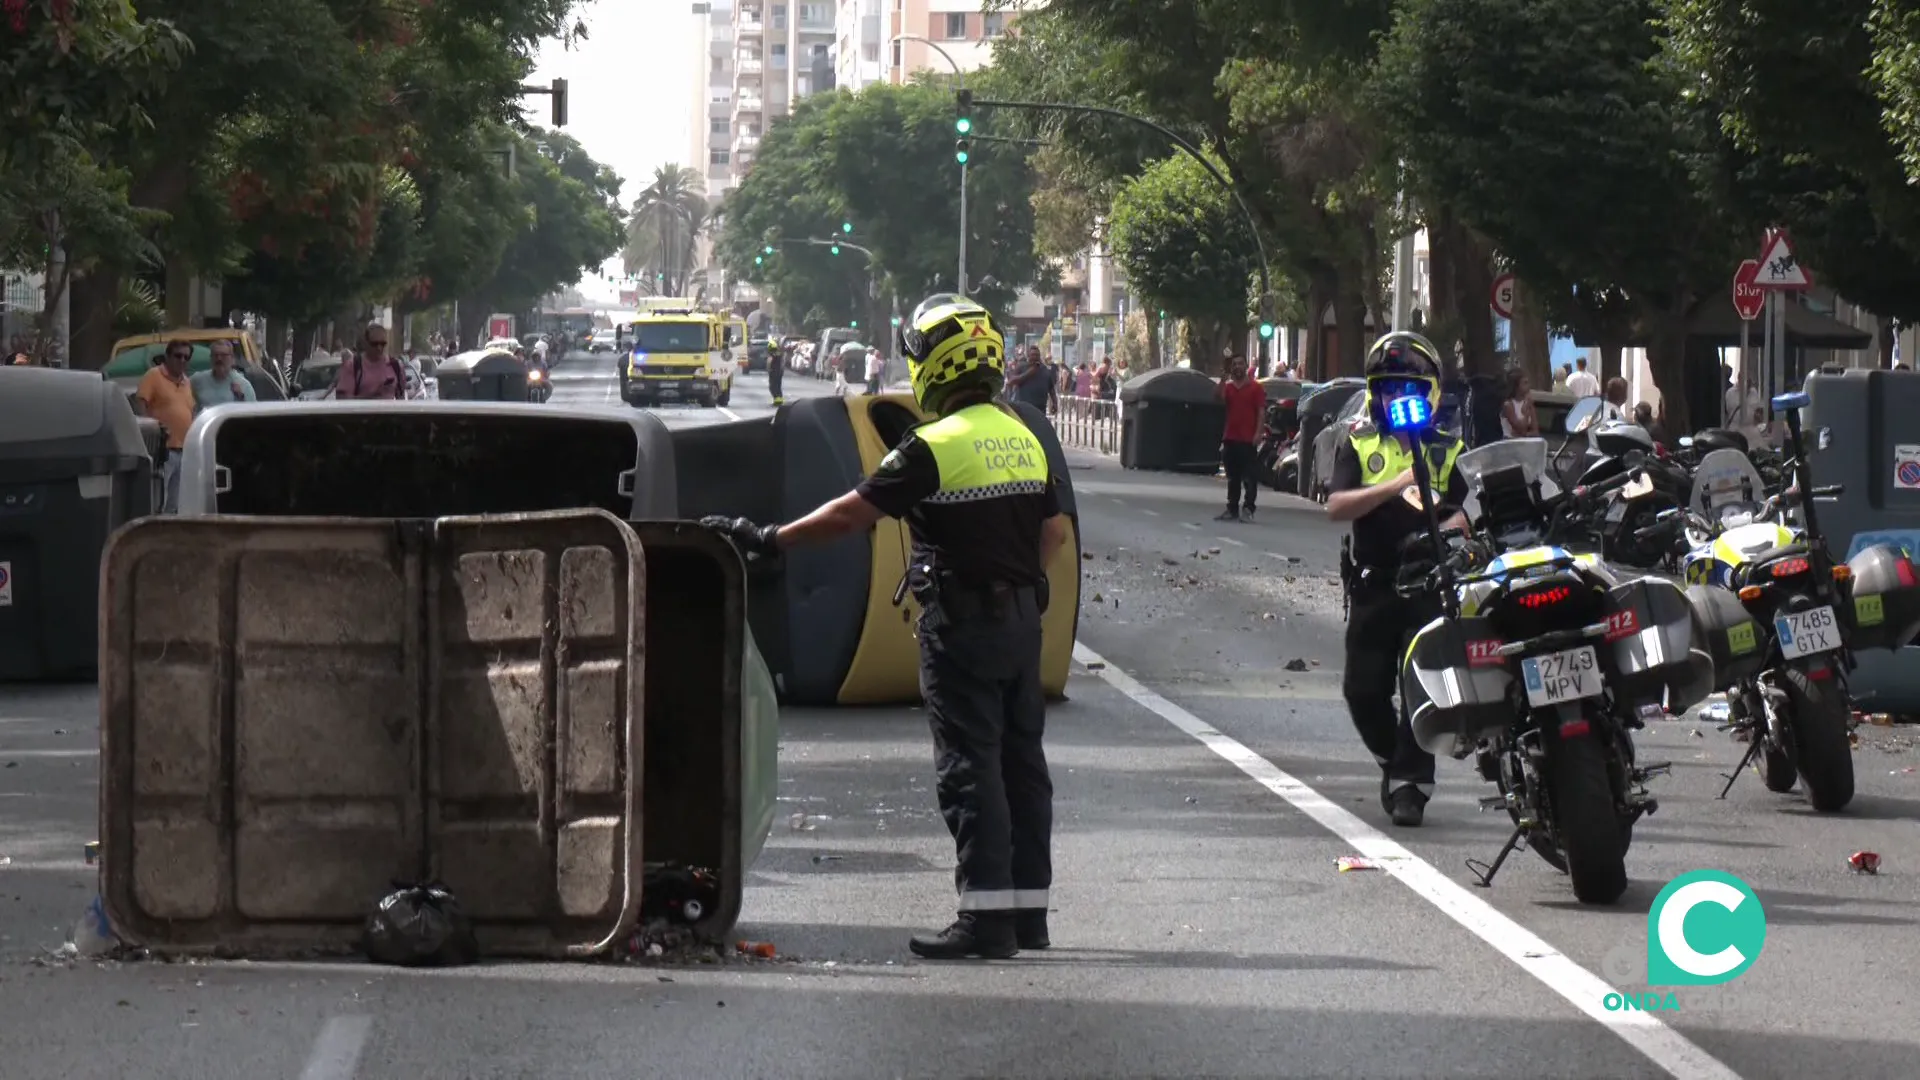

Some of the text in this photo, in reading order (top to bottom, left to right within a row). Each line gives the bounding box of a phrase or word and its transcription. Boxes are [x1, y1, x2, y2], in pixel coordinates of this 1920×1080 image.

[1737, 283, 1761, 297] STOP
[973, 436, 1035, 454] POLICIA
[985, 453, 1036, 471] LOCAL
[1790, 608, 1832, 634] 7485
[1468, 640, 1501, 657] 112
[1796, 629, 1829, 653] GTX
[1541, 651, 1593, 679] 2749
[1544, 674, 1582, 700] MPV
